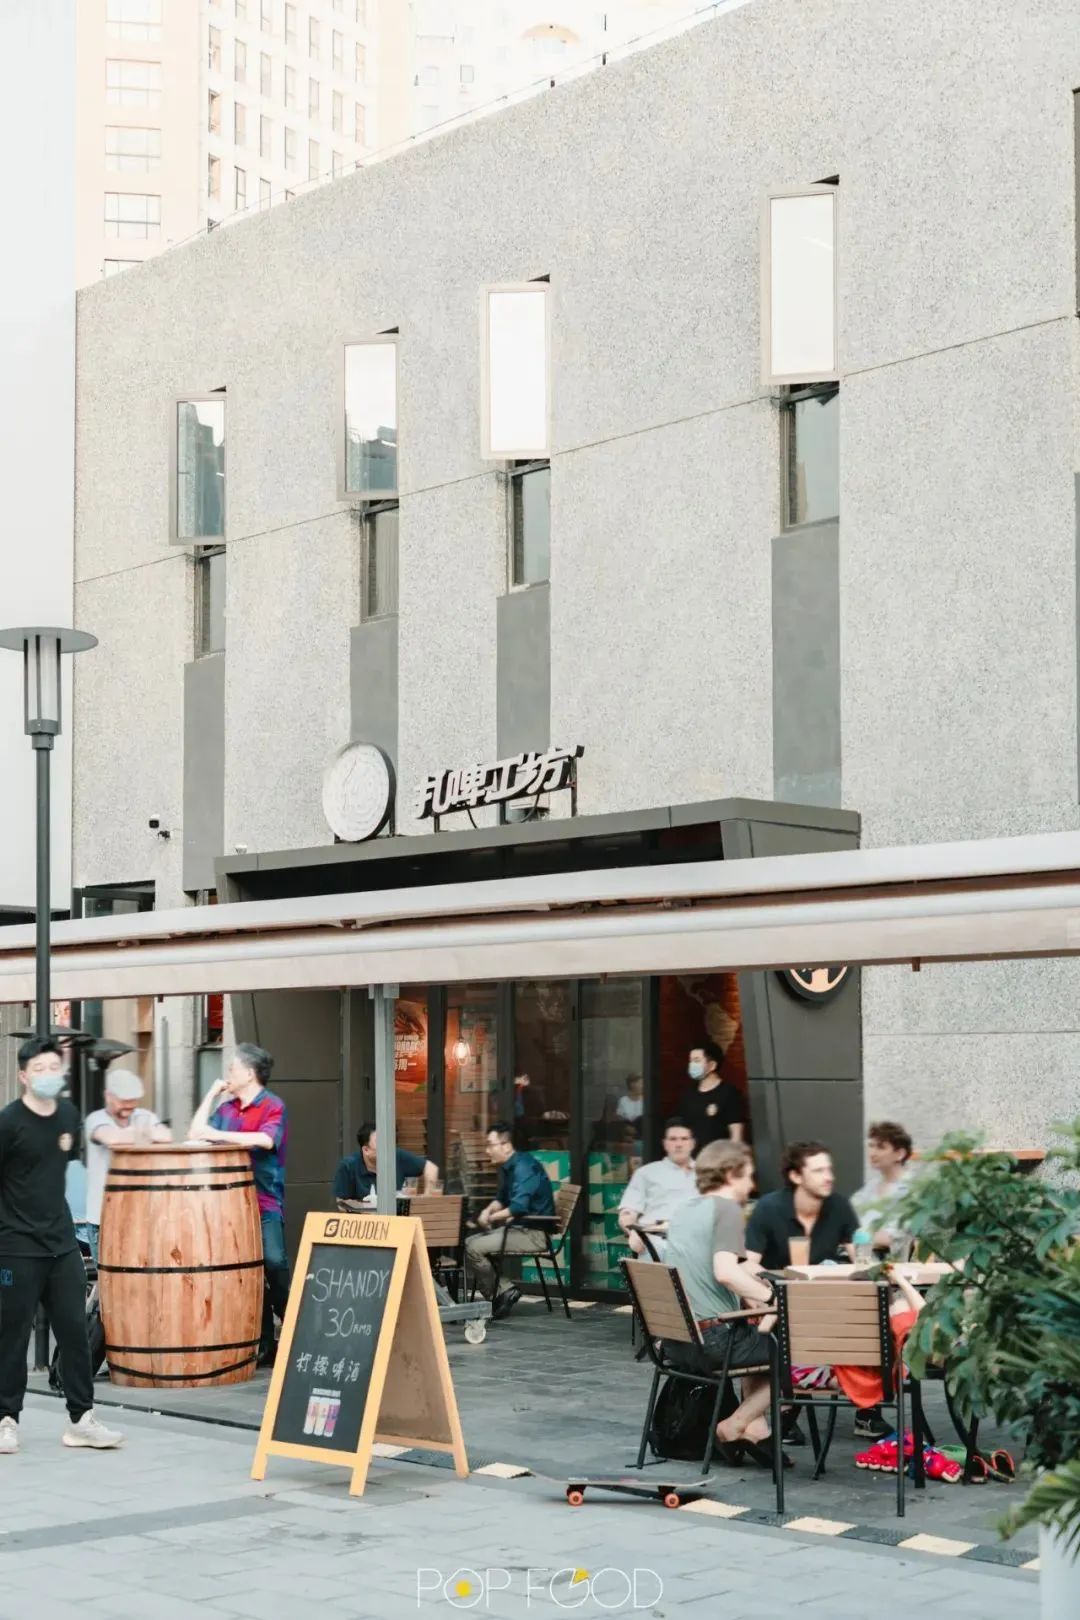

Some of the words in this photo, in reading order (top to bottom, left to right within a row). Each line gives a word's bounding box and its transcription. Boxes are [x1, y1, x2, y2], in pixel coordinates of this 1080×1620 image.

[414, 745, 584, 819] 扎啤工坊
[339, 1219, 390, 1240] GOUDEN
[311, 1267, 390, 1302] SHANDY
